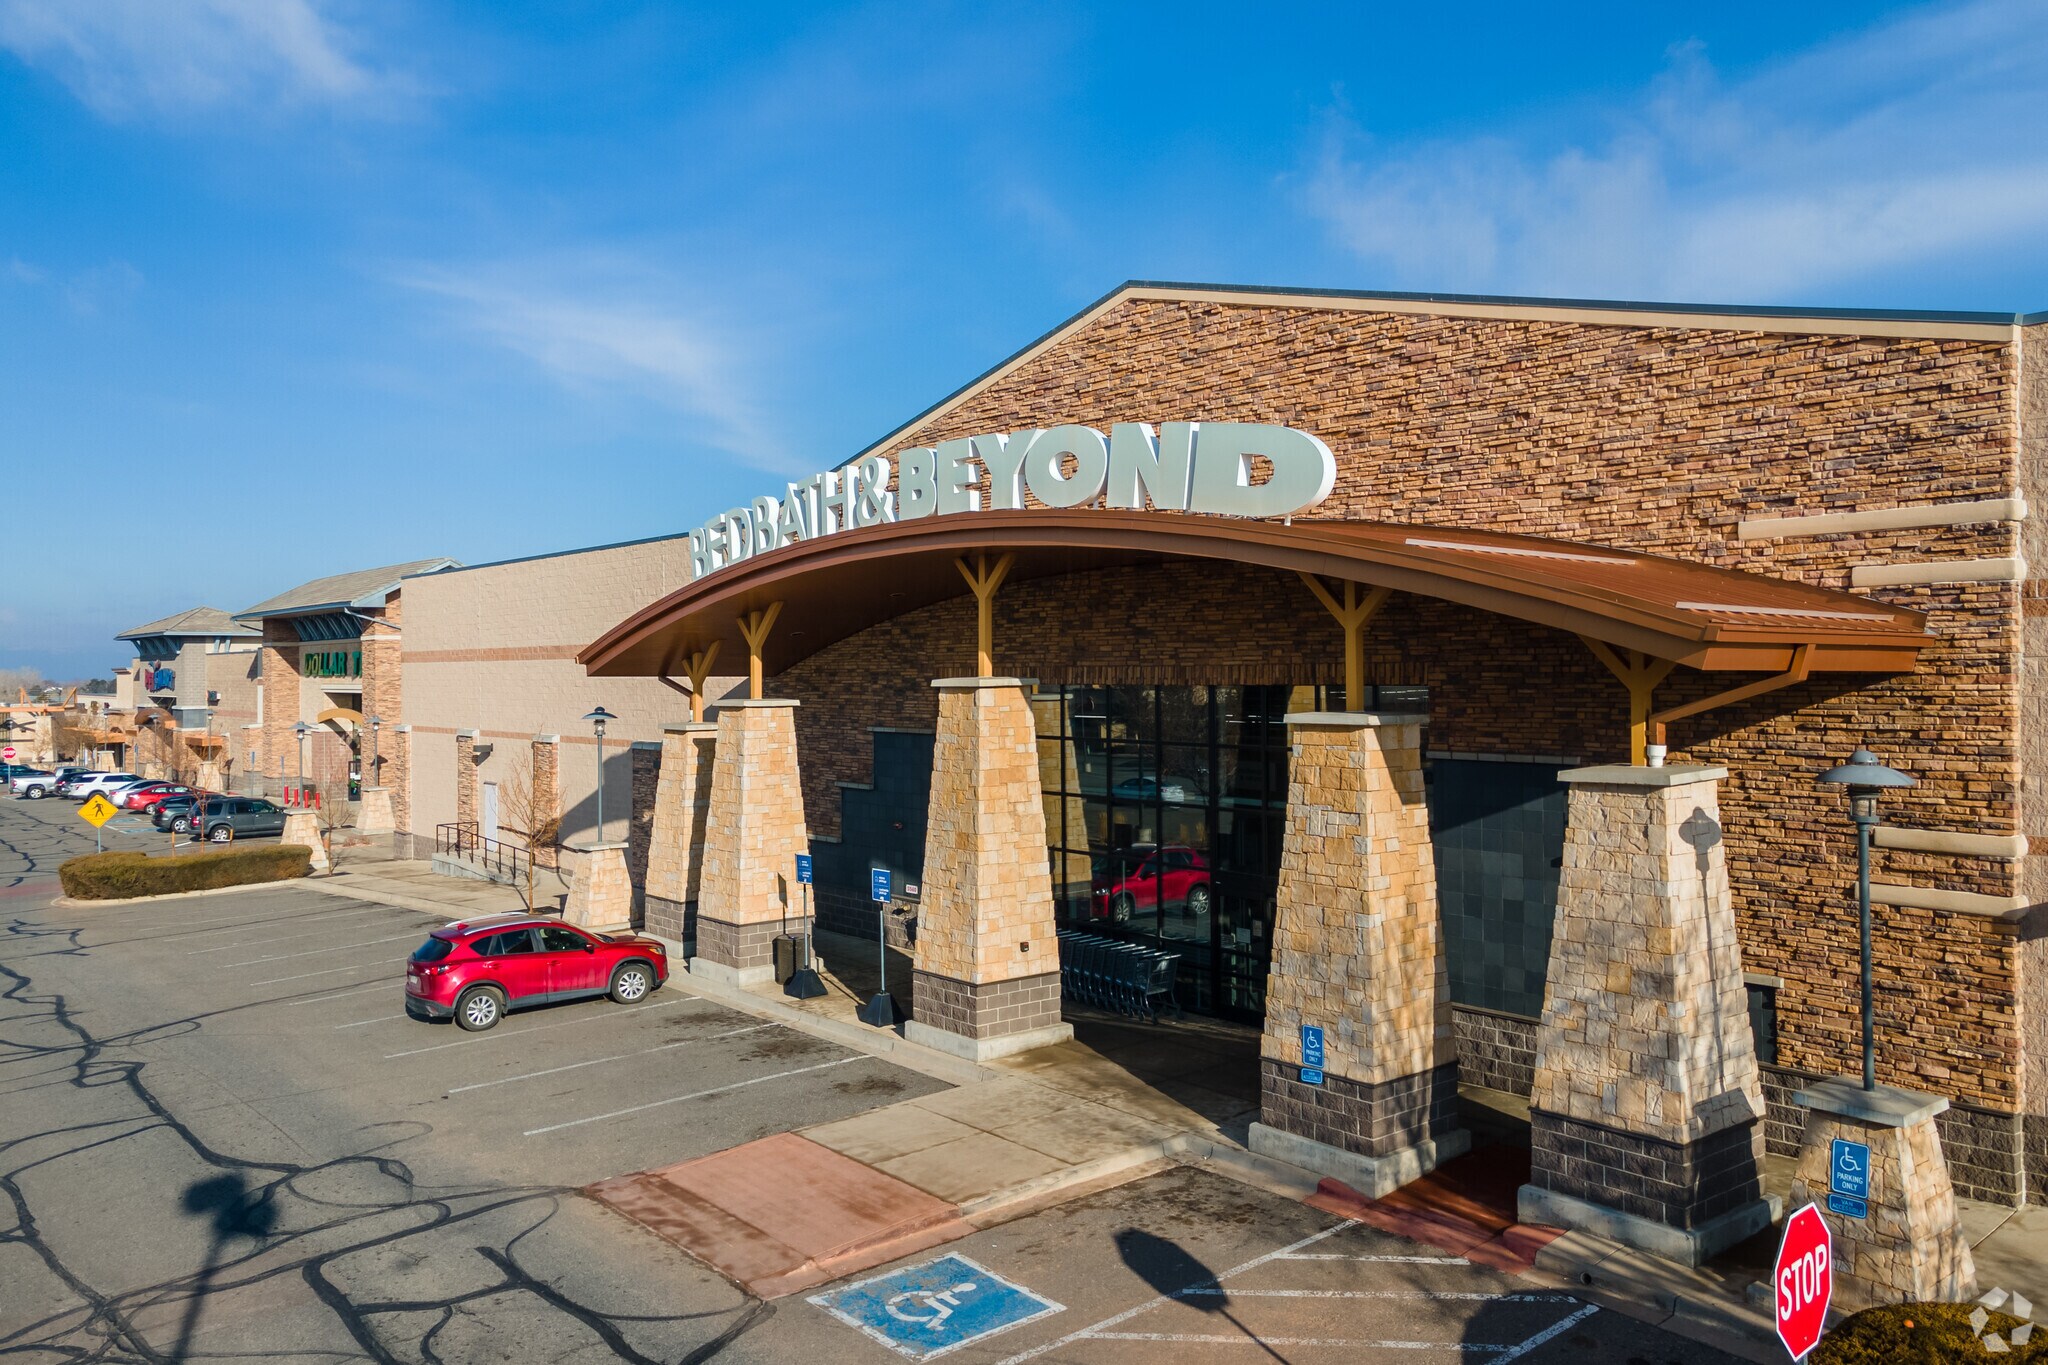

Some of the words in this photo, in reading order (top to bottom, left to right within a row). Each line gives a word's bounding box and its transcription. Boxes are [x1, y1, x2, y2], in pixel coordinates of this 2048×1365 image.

[689, 507, 753, 580] BED
[752, 465, 859, 555] BATH
[856, 457, 898, 525] &
[899, 422, 1337, 521] BEYOND
[305, 652, 347, 678] DOLLAR
[1837, 1172, 1863, 1184] PARKING
[1842, 1181, 1858, 1191] ONLY
[1780, 1243, 1827, 1321] STOP
